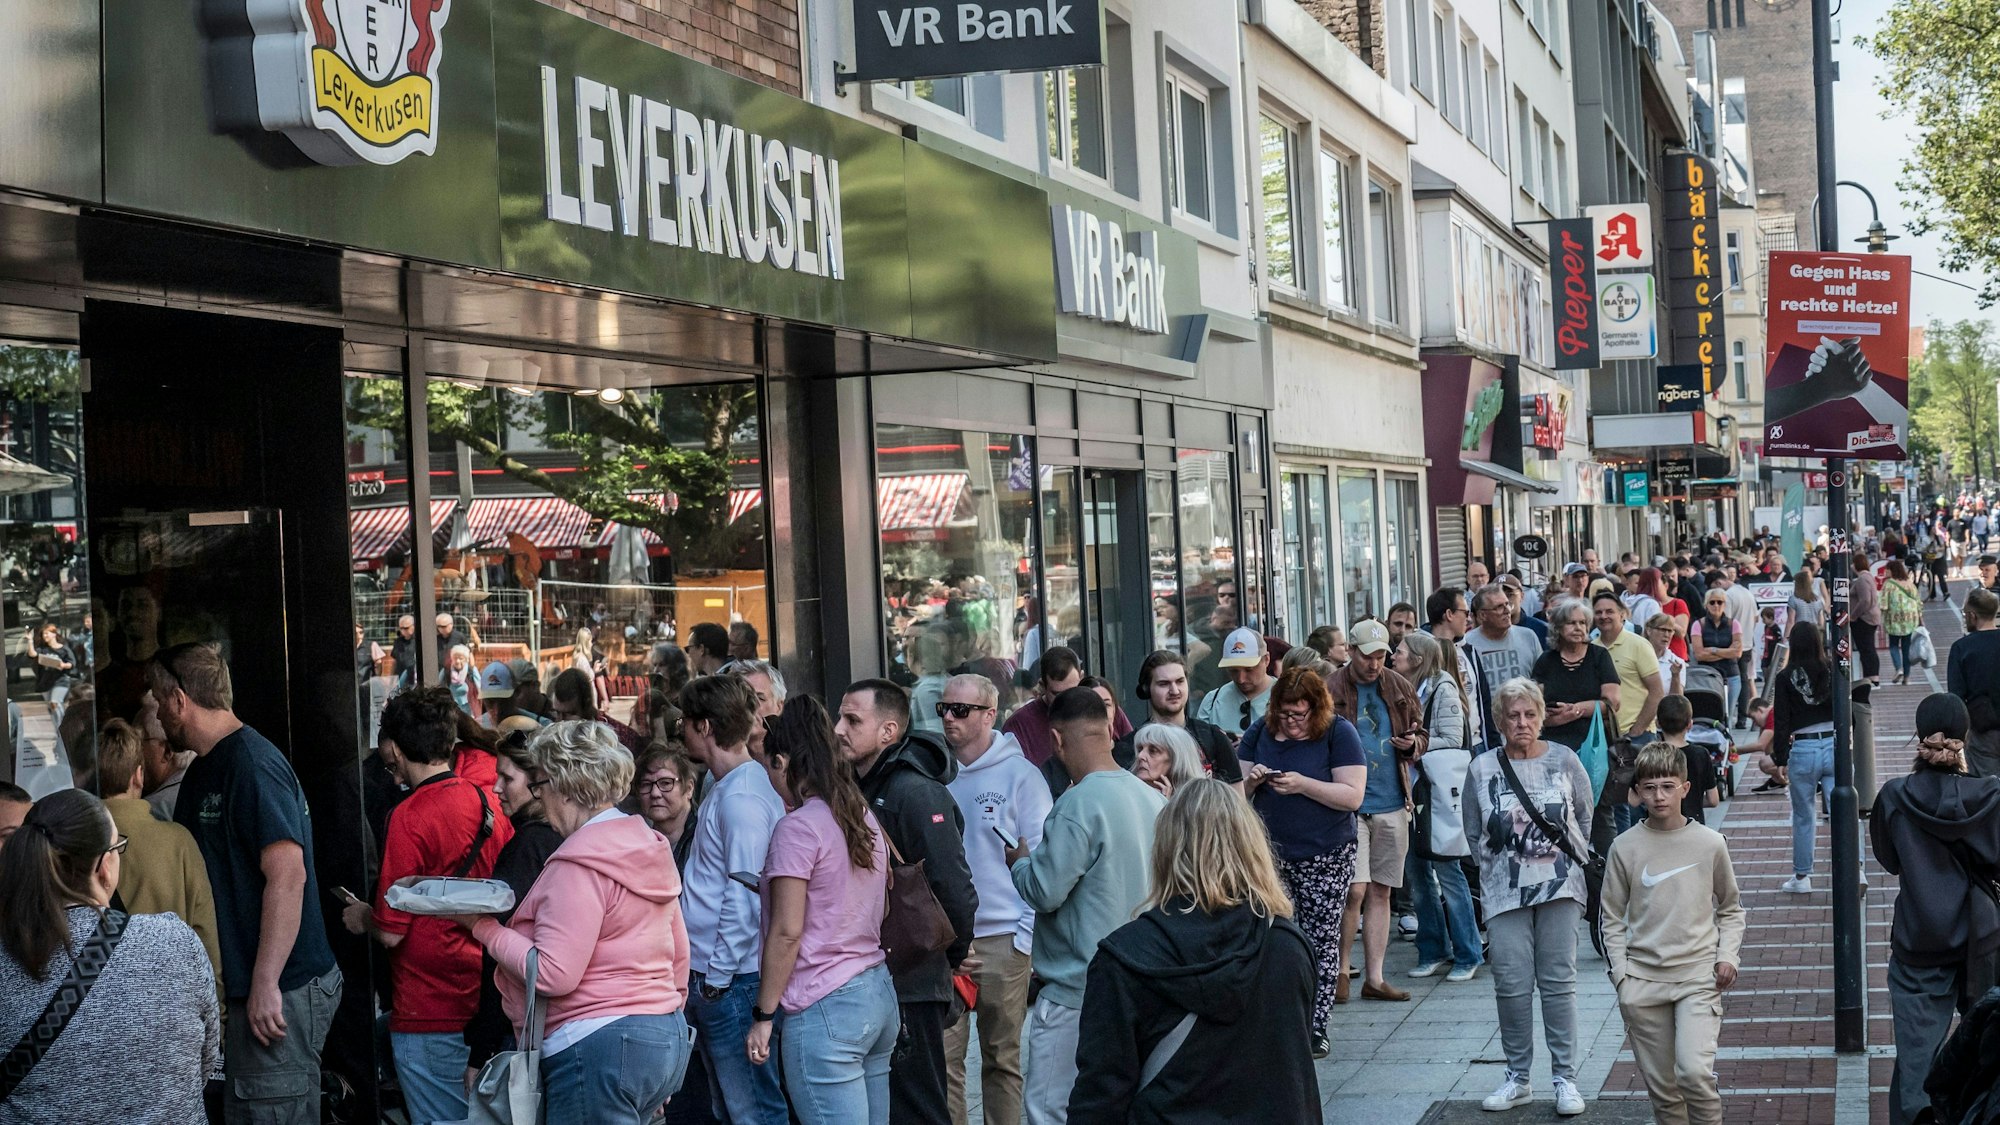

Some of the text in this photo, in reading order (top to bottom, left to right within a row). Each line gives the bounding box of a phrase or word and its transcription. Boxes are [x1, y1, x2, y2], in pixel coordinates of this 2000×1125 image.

[878, 0, 1075, 47] VR Bank
[322, 59, 423, 135] Leverkusen
[541, 66, 845, 281] LEVERKUSEN
[1058, 206, 1169, 334] VR Bank
[1687, 157, 1713, 394] bäckerei
[1790, 264, 1891, 281] Gegen Hass
[1558, 230, 1592, 356] Pieper
[1824, 282, 1857, 296] und
[1617, 286, 1625, 319] BAYER
[1780, 298, 1898, 314] rechte Hetze!
[1601, 332, 1638, 340] Germania
[1605, 338, 1640, 348] Apotheke
[1852, 436, 1868, 446] Die
[1522, 541, 1539, 551] 10€
[1482, 650, 1519, 671] NUR
[974, 791, 1007, 805] HILFIGER
